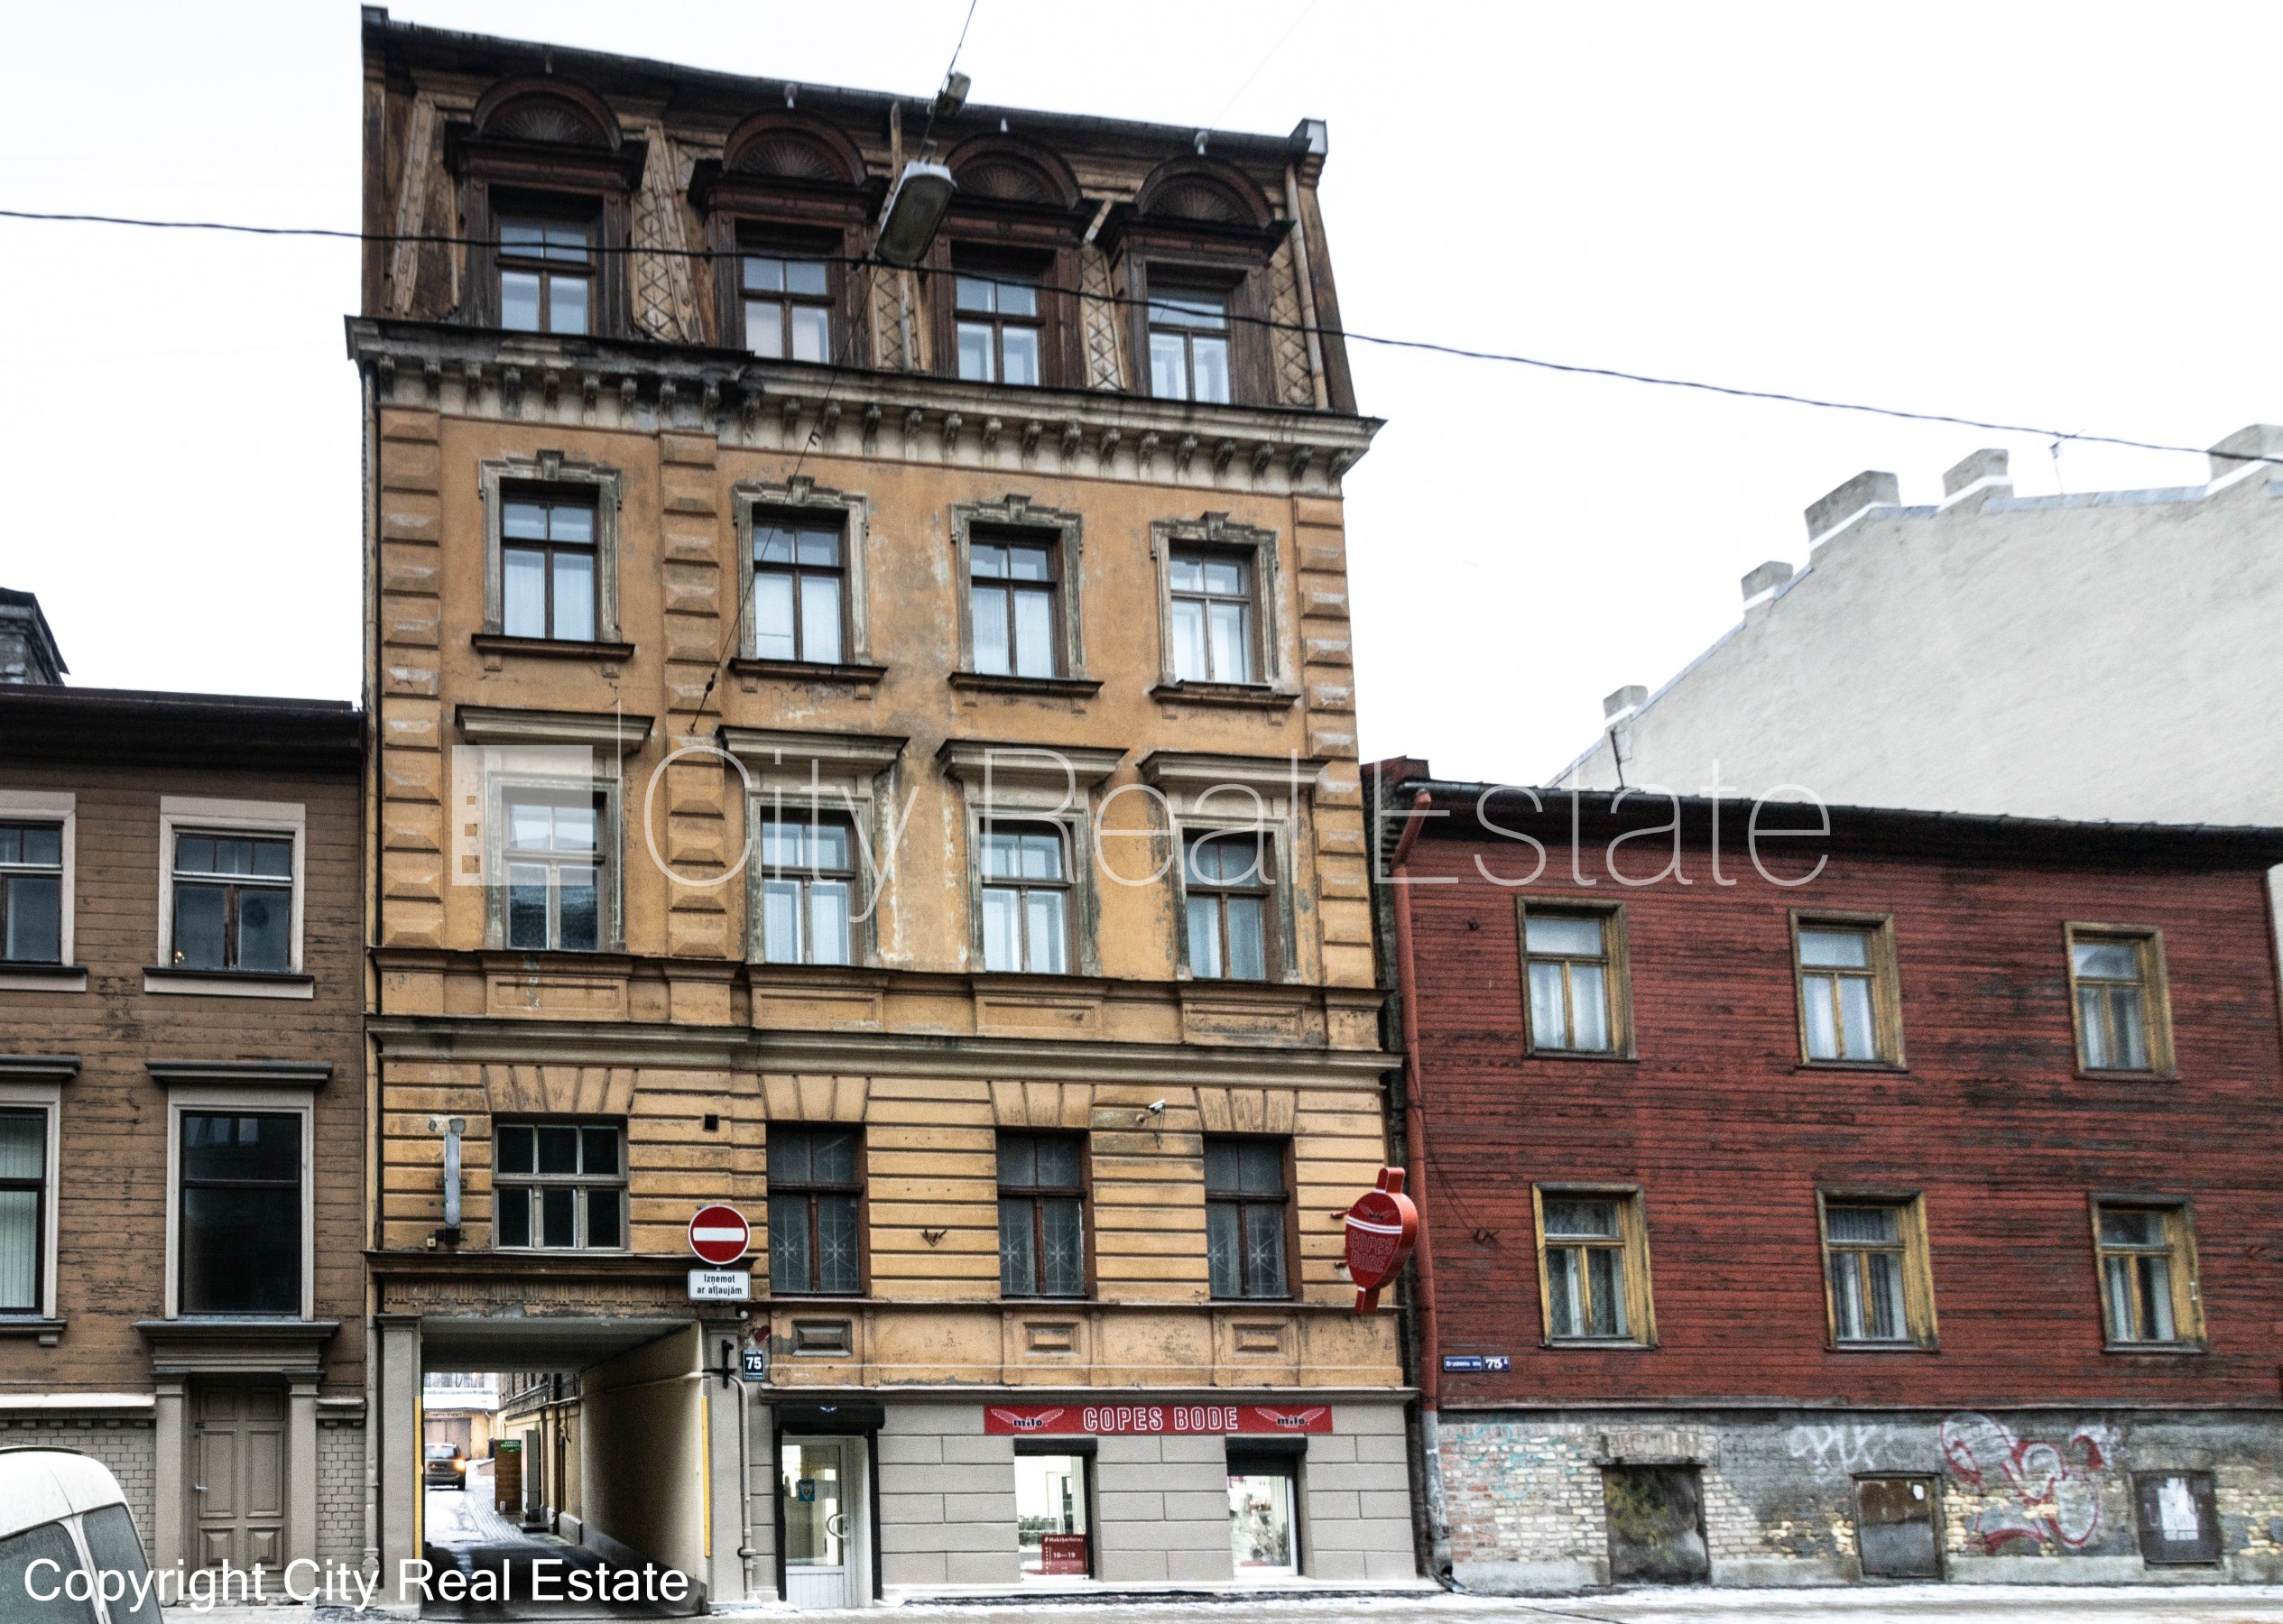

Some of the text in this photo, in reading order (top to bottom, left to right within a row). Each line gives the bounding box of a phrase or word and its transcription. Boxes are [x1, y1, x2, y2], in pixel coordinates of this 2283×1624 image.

[1349, 1231, 1395, 1255] COPES
[704, 1274, 735, 1285] Izņemot
[708, 1286, 743, 1296] atļaujām
[745, 1356, 763, 1370] 75
[1012, 1407, 1306, 1431] milo COPES BODE milo
